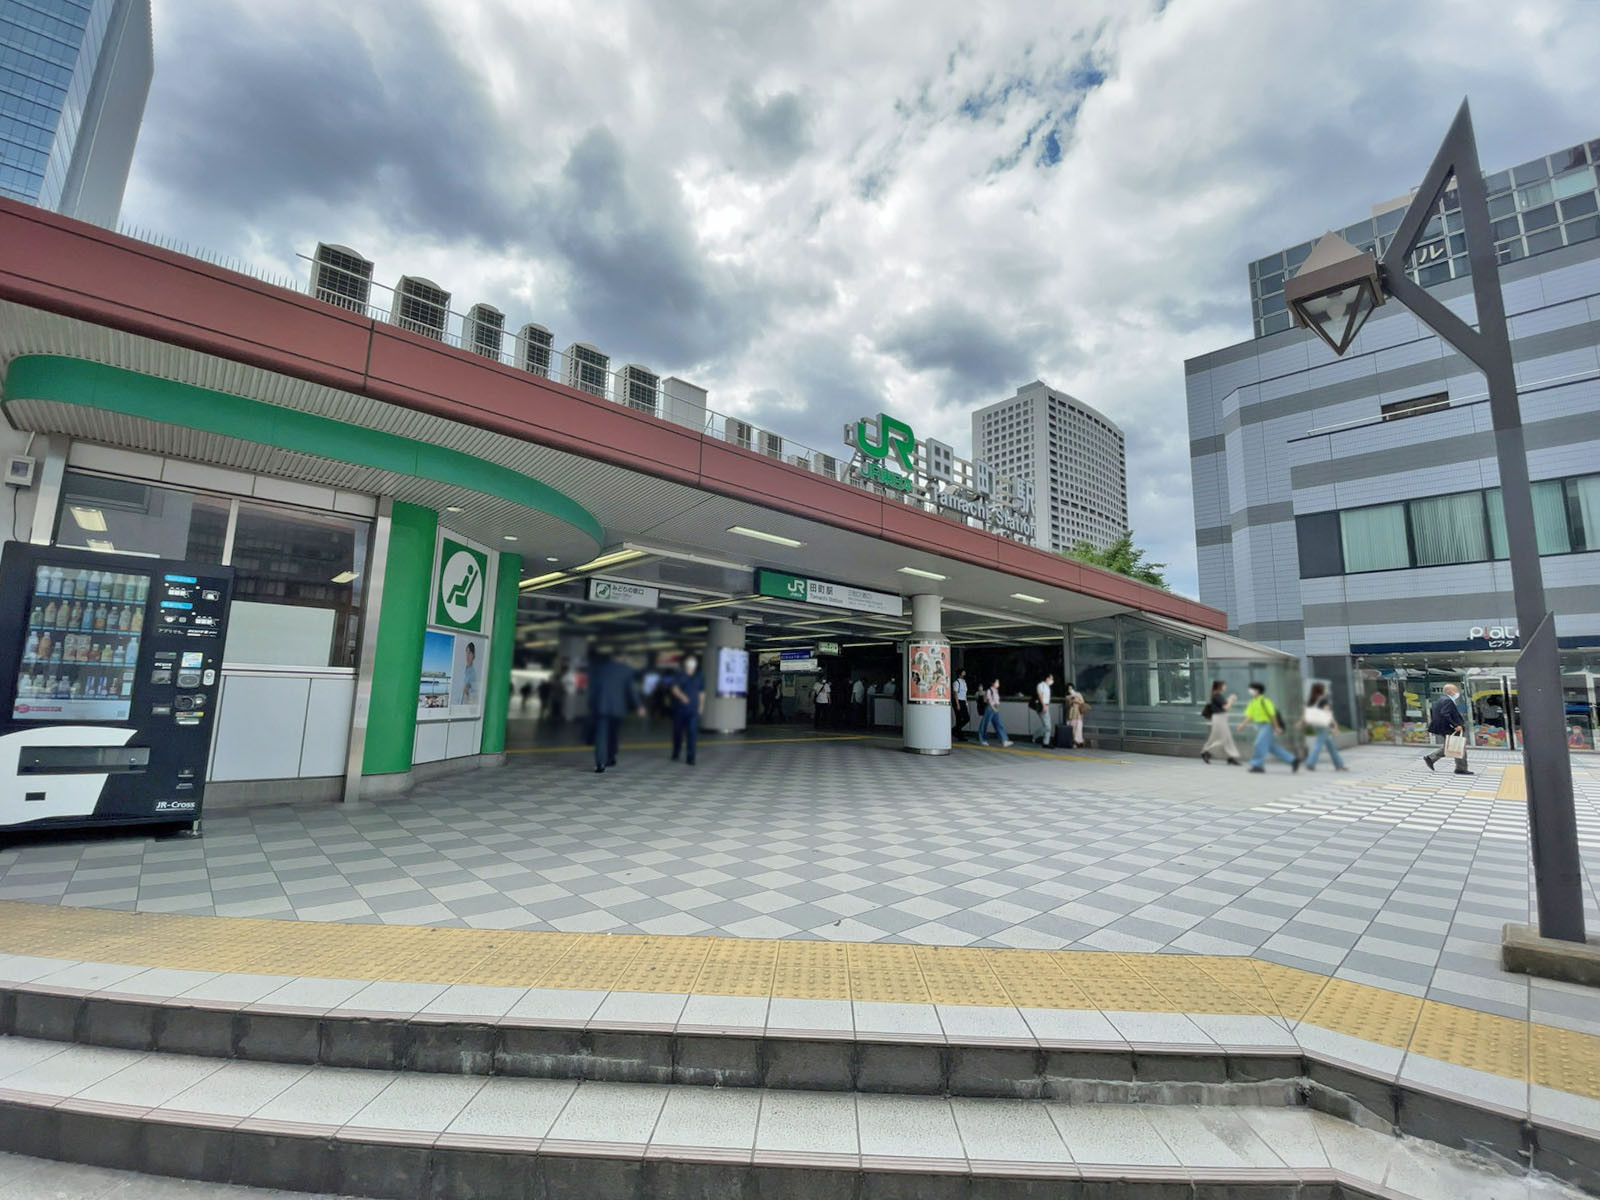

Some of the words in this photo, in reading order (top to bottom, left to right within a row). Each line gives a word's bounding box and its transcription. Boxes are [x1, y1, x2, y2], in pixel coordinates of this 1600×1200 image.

[857, 412, 914, 471] JR
[927, 437, 1035, 514] 田町駅
[928, 483, 990, 519] Tamachi
[995, 509, 1037, 537] Station
[787, 580, 805, 593] JR
[809, 583, 833, 595] 田町駅
[156, 801, 196, 809] JR-Cross
